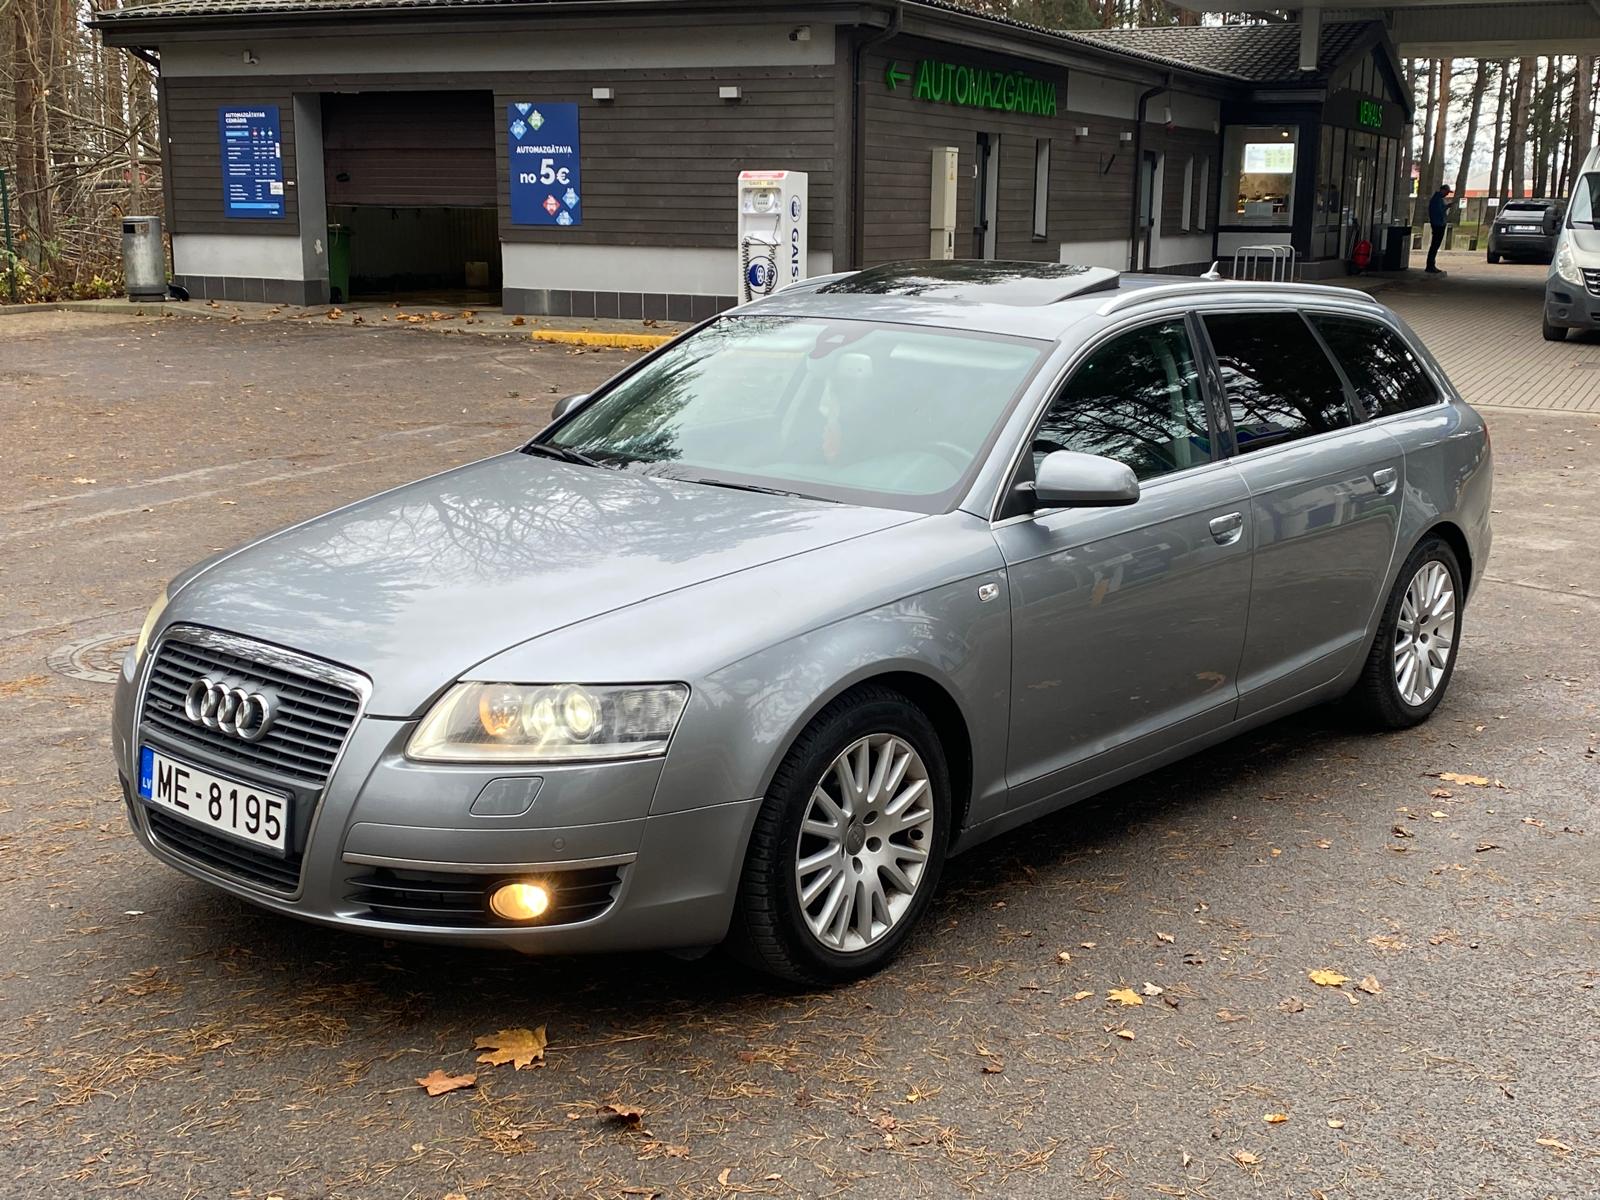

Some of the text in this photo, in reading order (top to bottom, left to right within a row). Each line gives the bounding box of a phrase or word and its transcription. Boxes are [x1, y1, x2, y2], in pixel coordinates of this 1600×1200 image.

[914, 59, 1057, 117] AUTOMAZGĀTAVA
[516, 144, 572, 154] AUTOMAZGĀTAVA
[520, 158, 570, 185] no 5€
[791, 228, 799, 283] GAIS
[142, 777, 152, 789] LV
[157, 759, 282, 841] ME-8195
